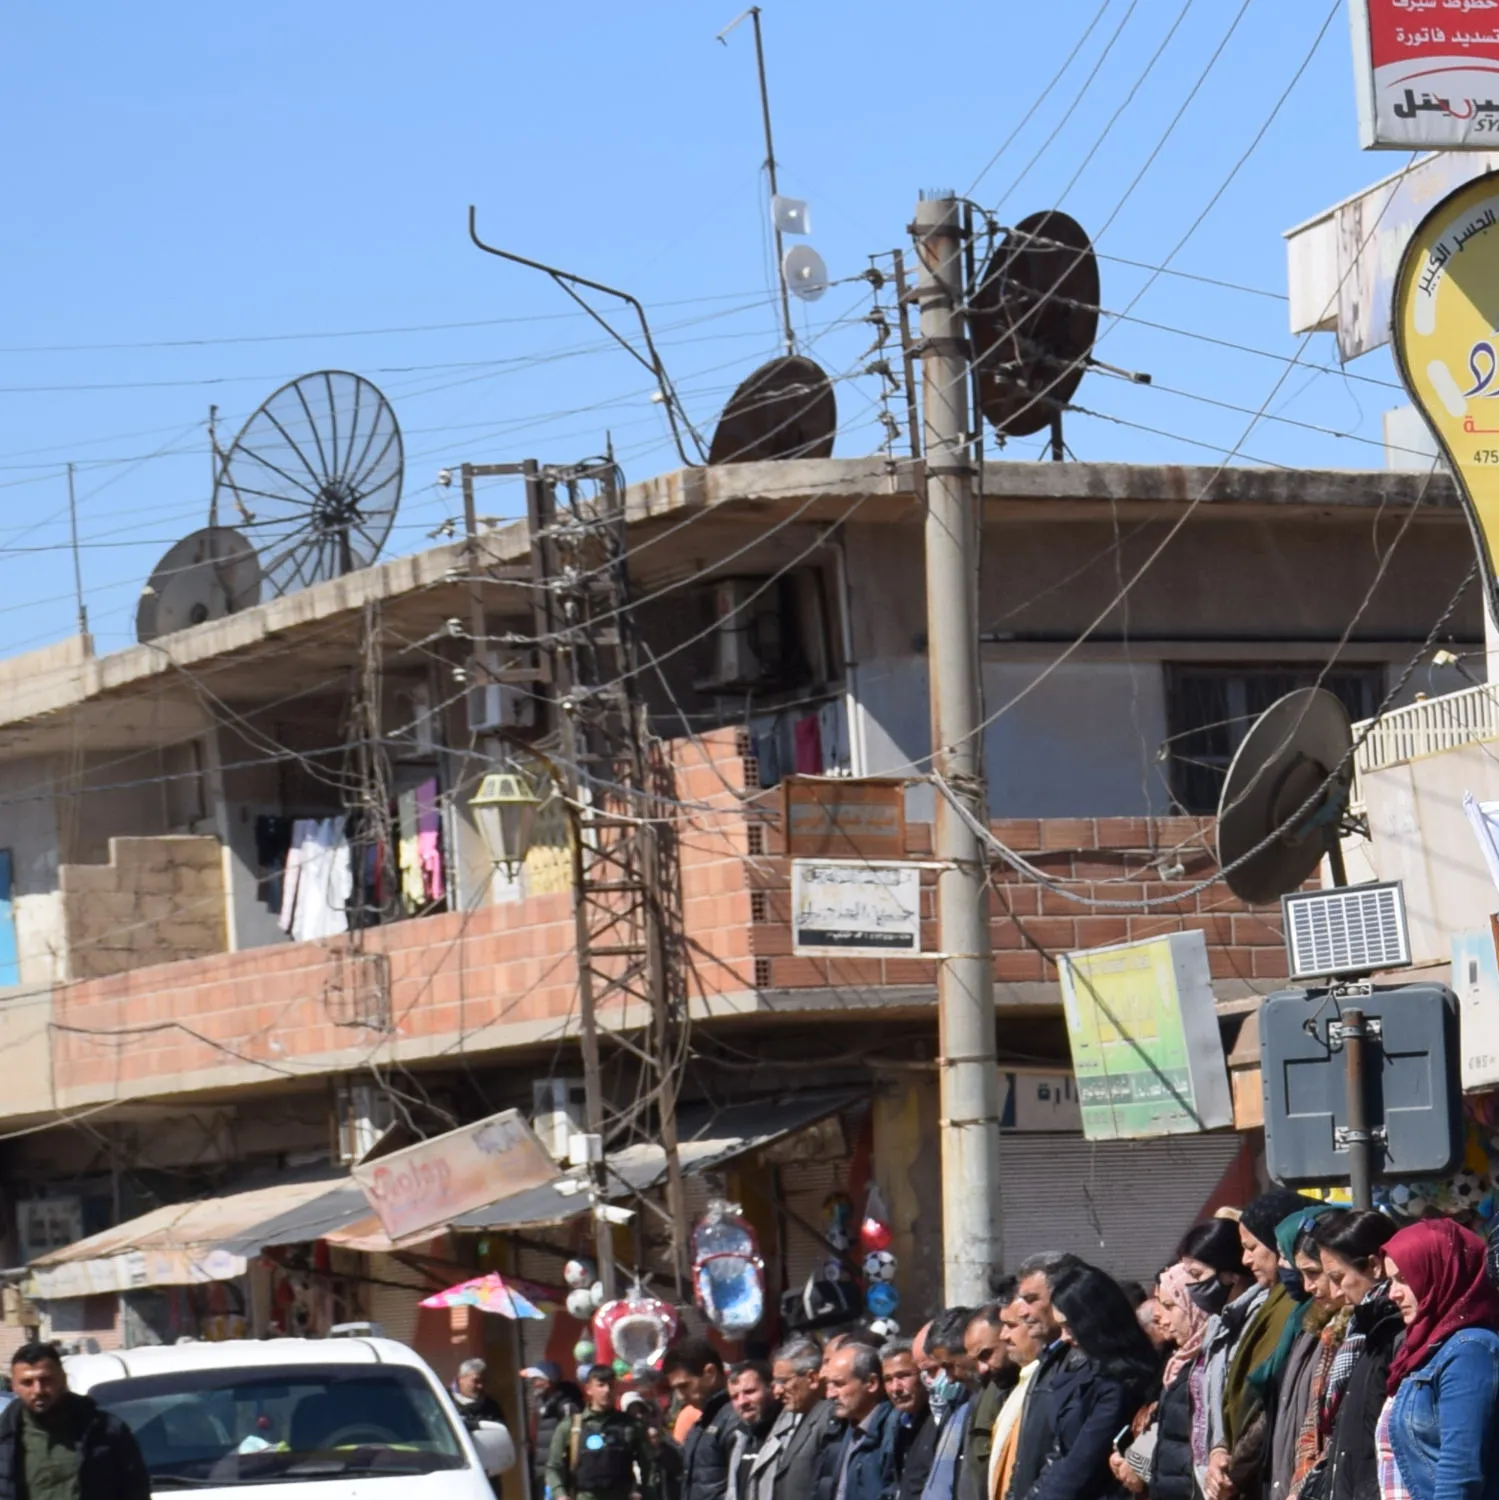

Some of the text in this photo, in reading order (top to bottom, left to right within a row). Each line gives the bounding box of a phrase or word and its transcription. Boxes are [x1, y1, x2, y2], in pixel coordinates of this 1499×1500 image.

[1396, 27, 1446, 46] فاتورة
[1452, 209, 1497, 252] الجسر
[1418, 242, 1452, 297] الكبير
